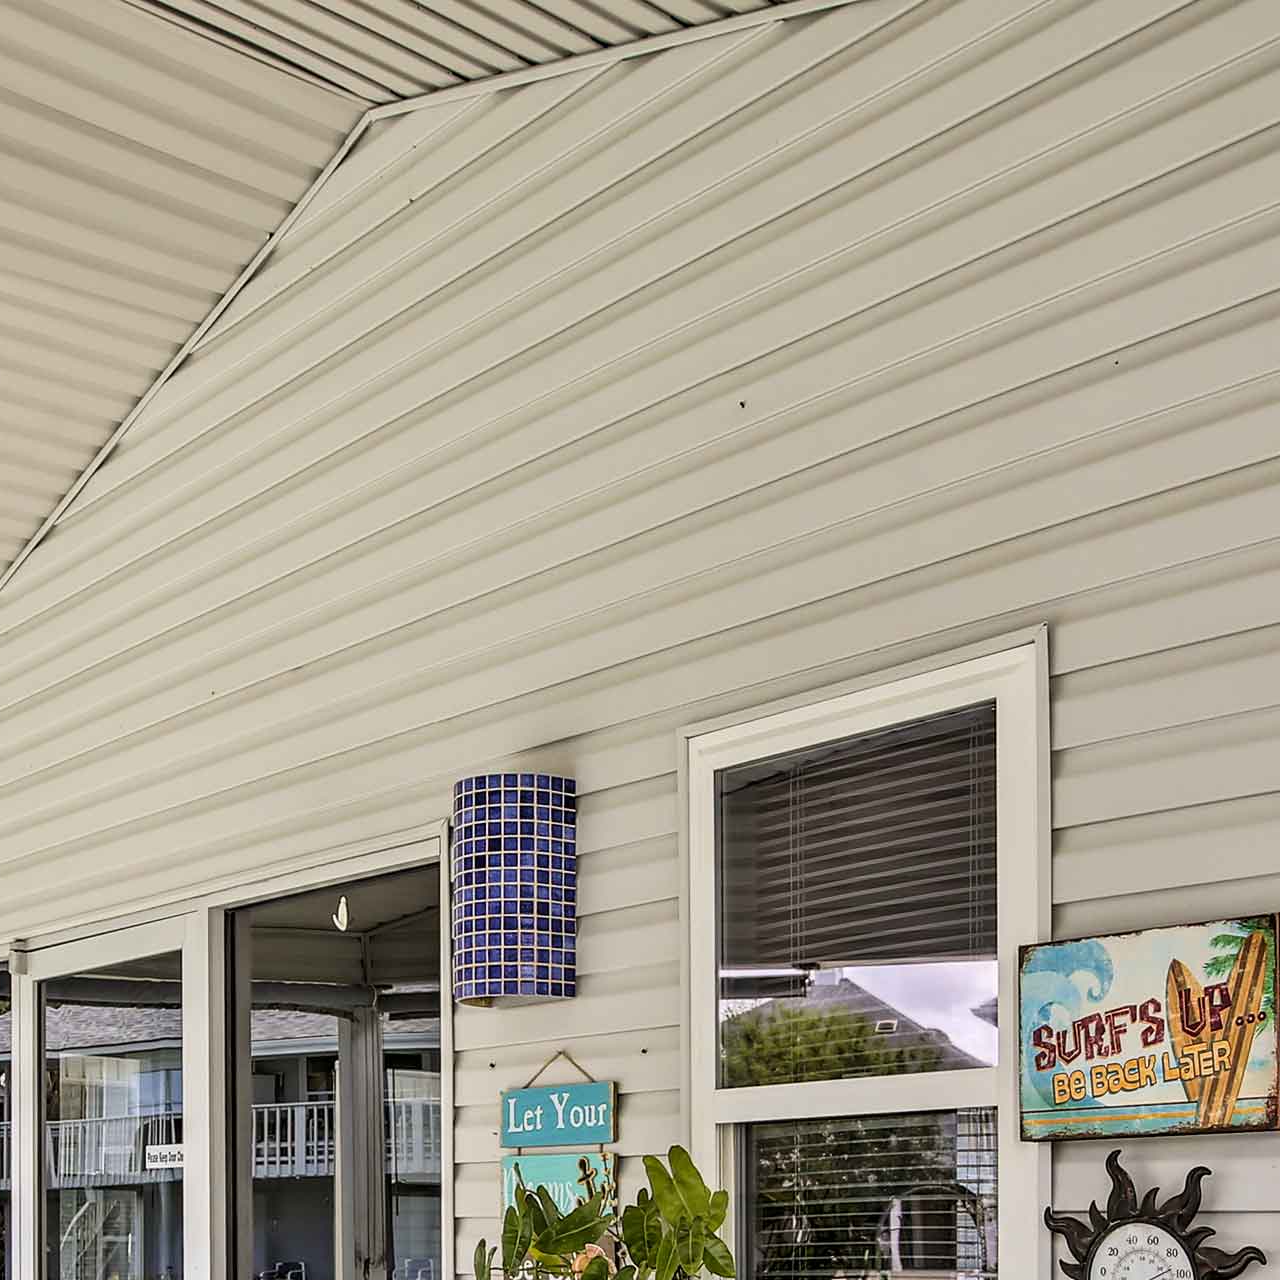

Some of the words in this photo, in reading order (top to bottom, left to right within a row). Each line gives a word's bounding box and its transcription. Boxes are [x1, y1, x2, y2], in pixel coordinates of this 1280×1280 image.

[1033, 998, 1165, 1072] SURF'S
[506, 1097, 544, 1133] Let
[549, 1092, 607, 1129] Your
[1147, 1235, 1159, 1245] 60
[1108, 1247, 1119, 1256] 20
[1166, 1247, 1178, 1257] 80
[1100, 1267, 1107, 1276] 0
[1175, 1269, 1191, 1279] 100
